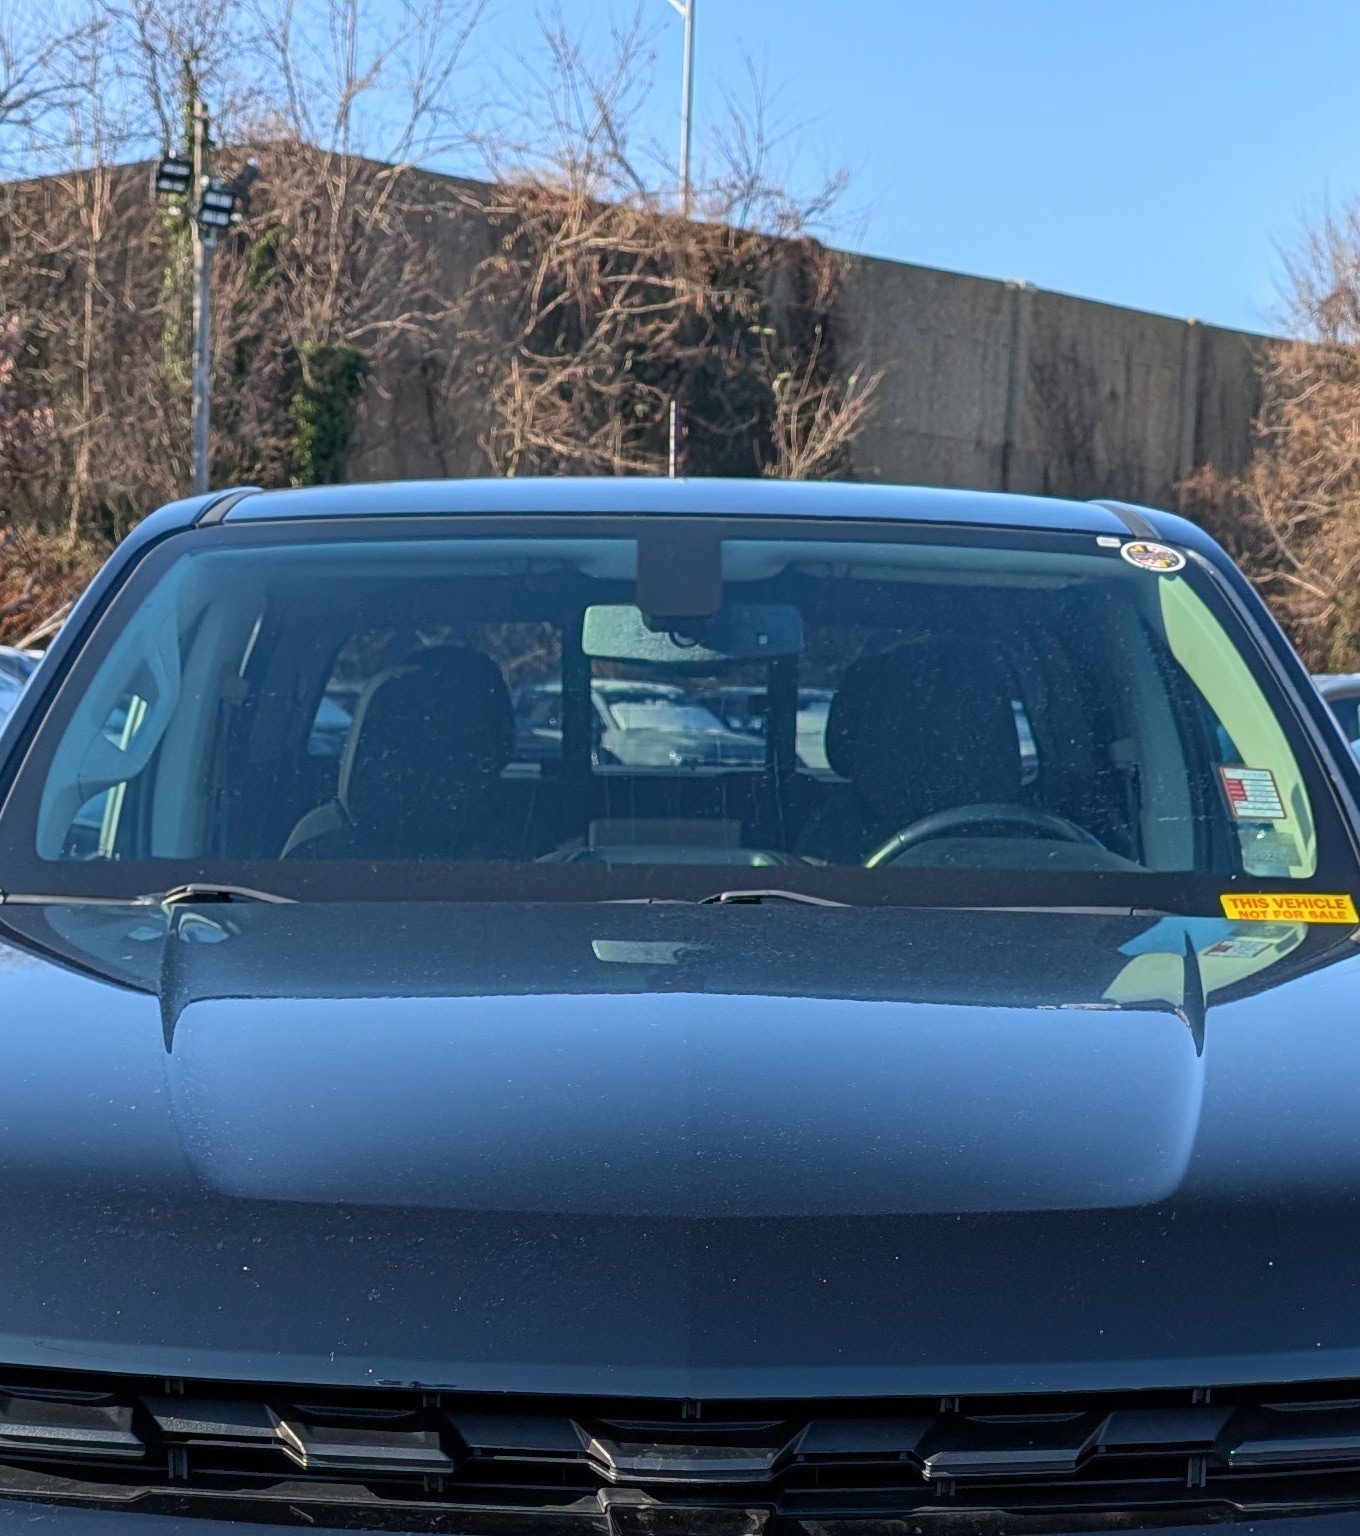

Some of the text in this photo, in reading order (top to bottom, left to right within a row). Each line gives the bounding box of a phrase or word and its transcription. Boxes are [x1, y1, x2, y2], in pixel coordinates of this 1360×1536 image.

[1228, 898, 1348, 909] THIS VEHICLE
[1238, 910, 1349, 919] NOT FOR SALE
